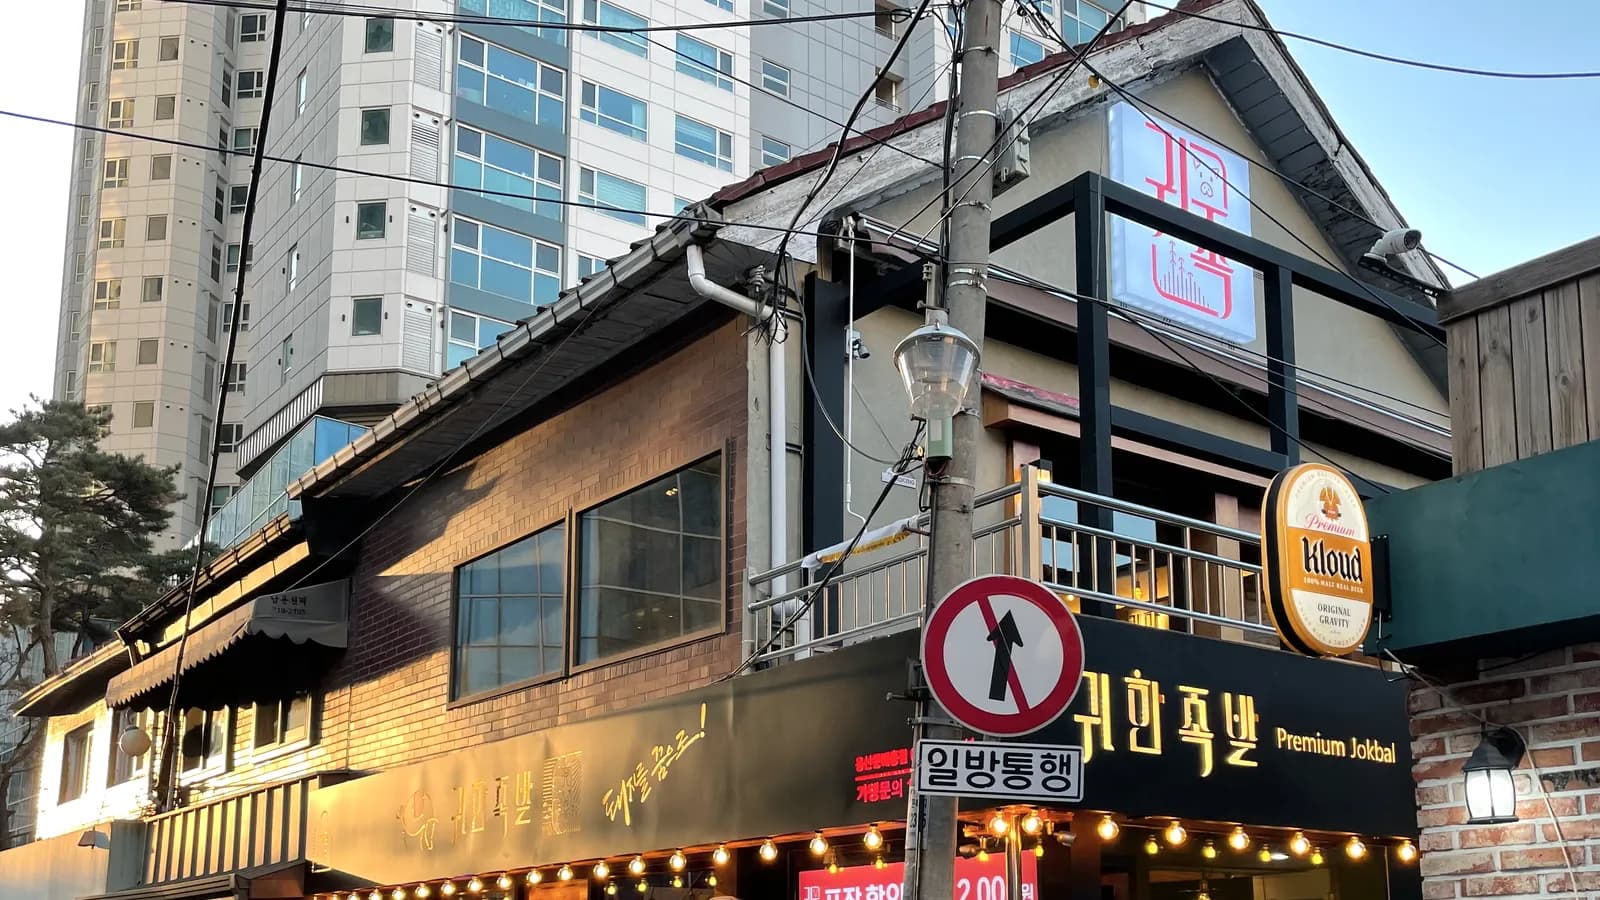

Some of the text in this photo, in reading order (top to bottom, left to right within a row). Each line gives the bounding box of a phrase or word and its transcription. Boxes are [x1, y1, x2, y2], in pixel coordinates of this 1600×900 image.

[1305, 512, 1356, 537] Premium
[1301, 536, 1363, 583] Kloud
[1317, 602, 1352, 617] ORIGINAL
[1319, 615, 1350, 629] GRAVITY
[1276, 726, 1396, 765] Premium Jokbal
[927, 746, 1073, 794] 일방통행
[856, 778, 903, 803] 가맹문의
